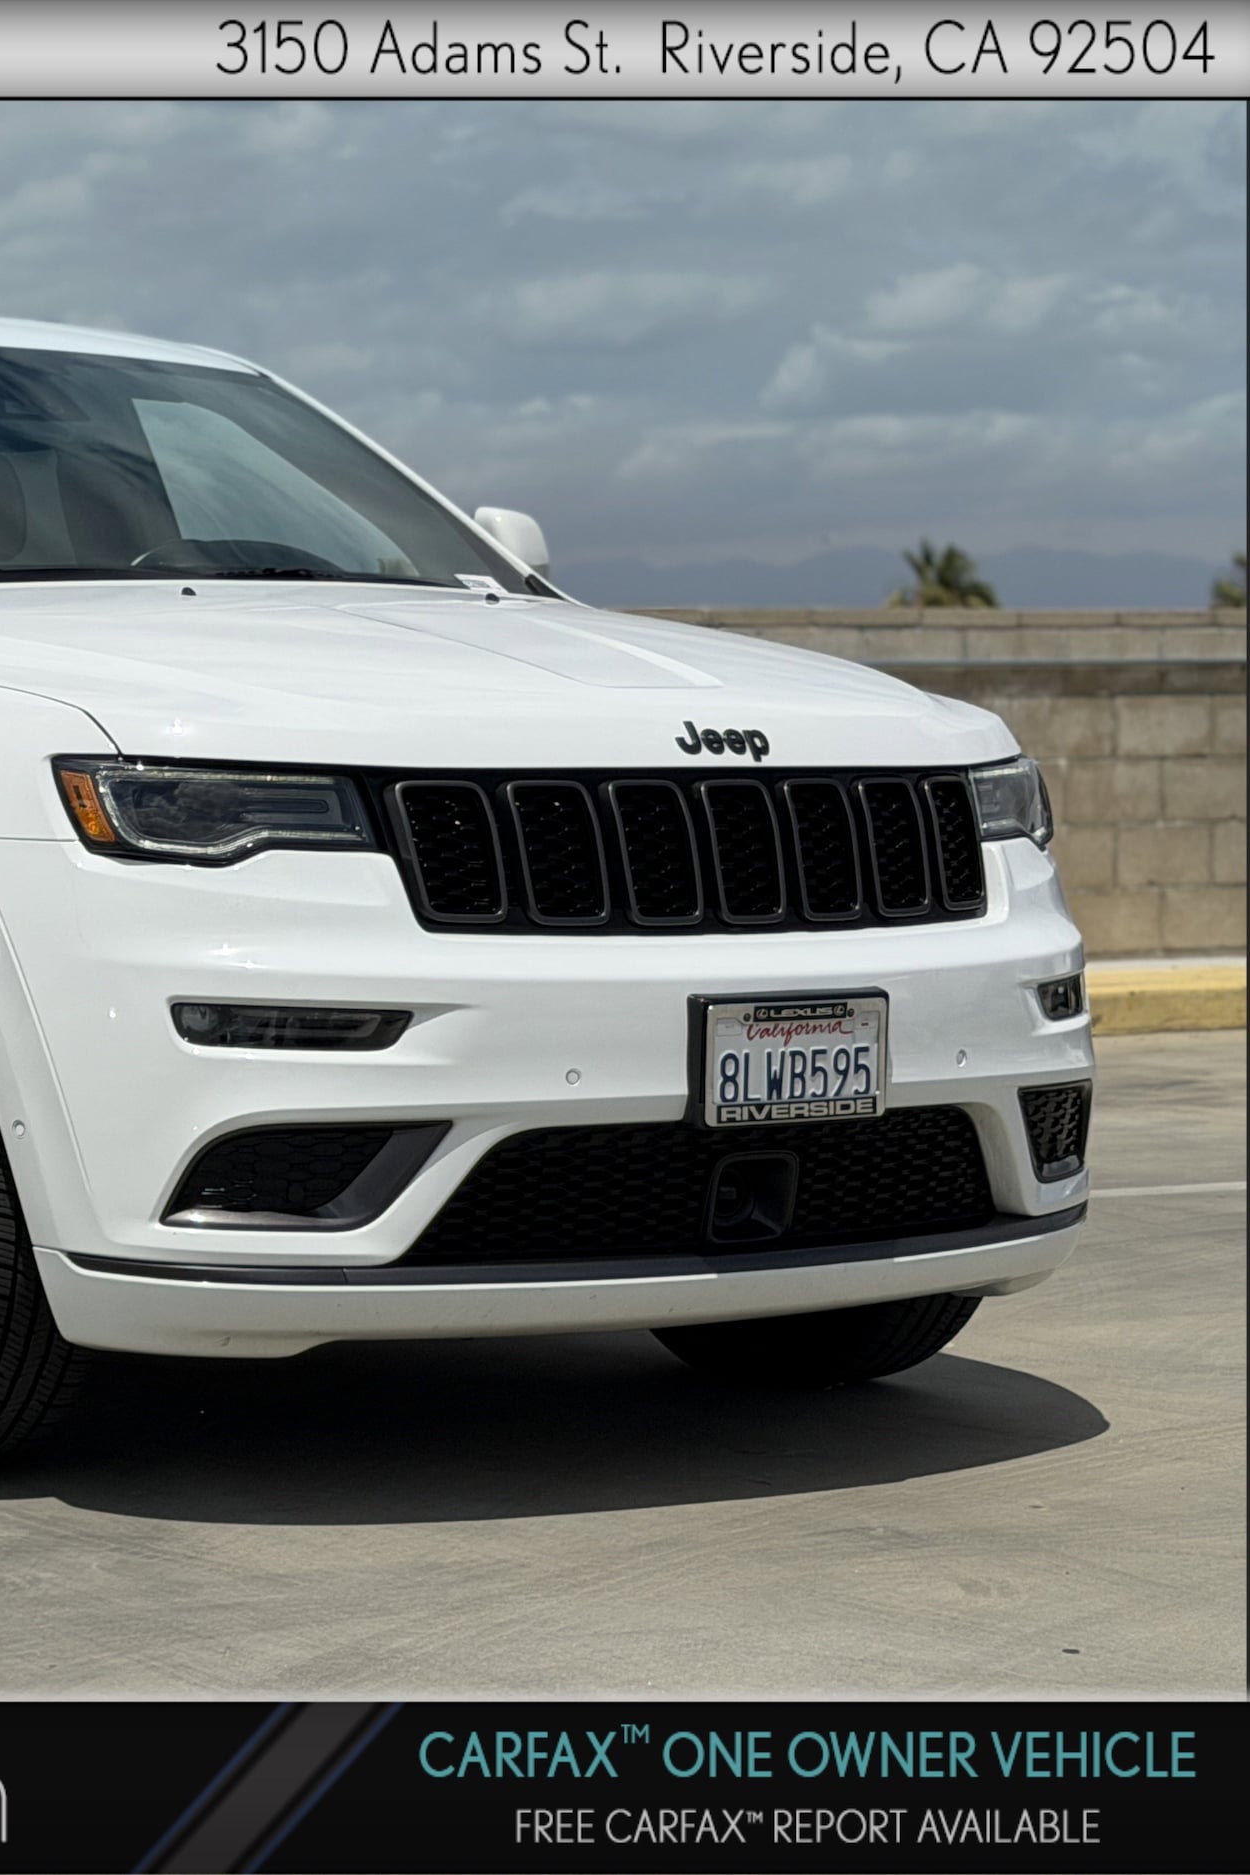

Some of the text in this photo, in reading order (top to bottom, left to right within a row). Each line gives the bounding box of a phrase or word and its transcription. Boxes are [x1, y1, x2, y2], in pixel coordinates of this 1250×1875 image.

[675, 720, 770, 762] Jeep
[769, 1005, 833, 1018] LEXUS
[746, 1020, 853, 1047] California
[719, 1045, 871, 1103] 8LWB595
[720, 1098, 874, 1122] RIVERSIDE
